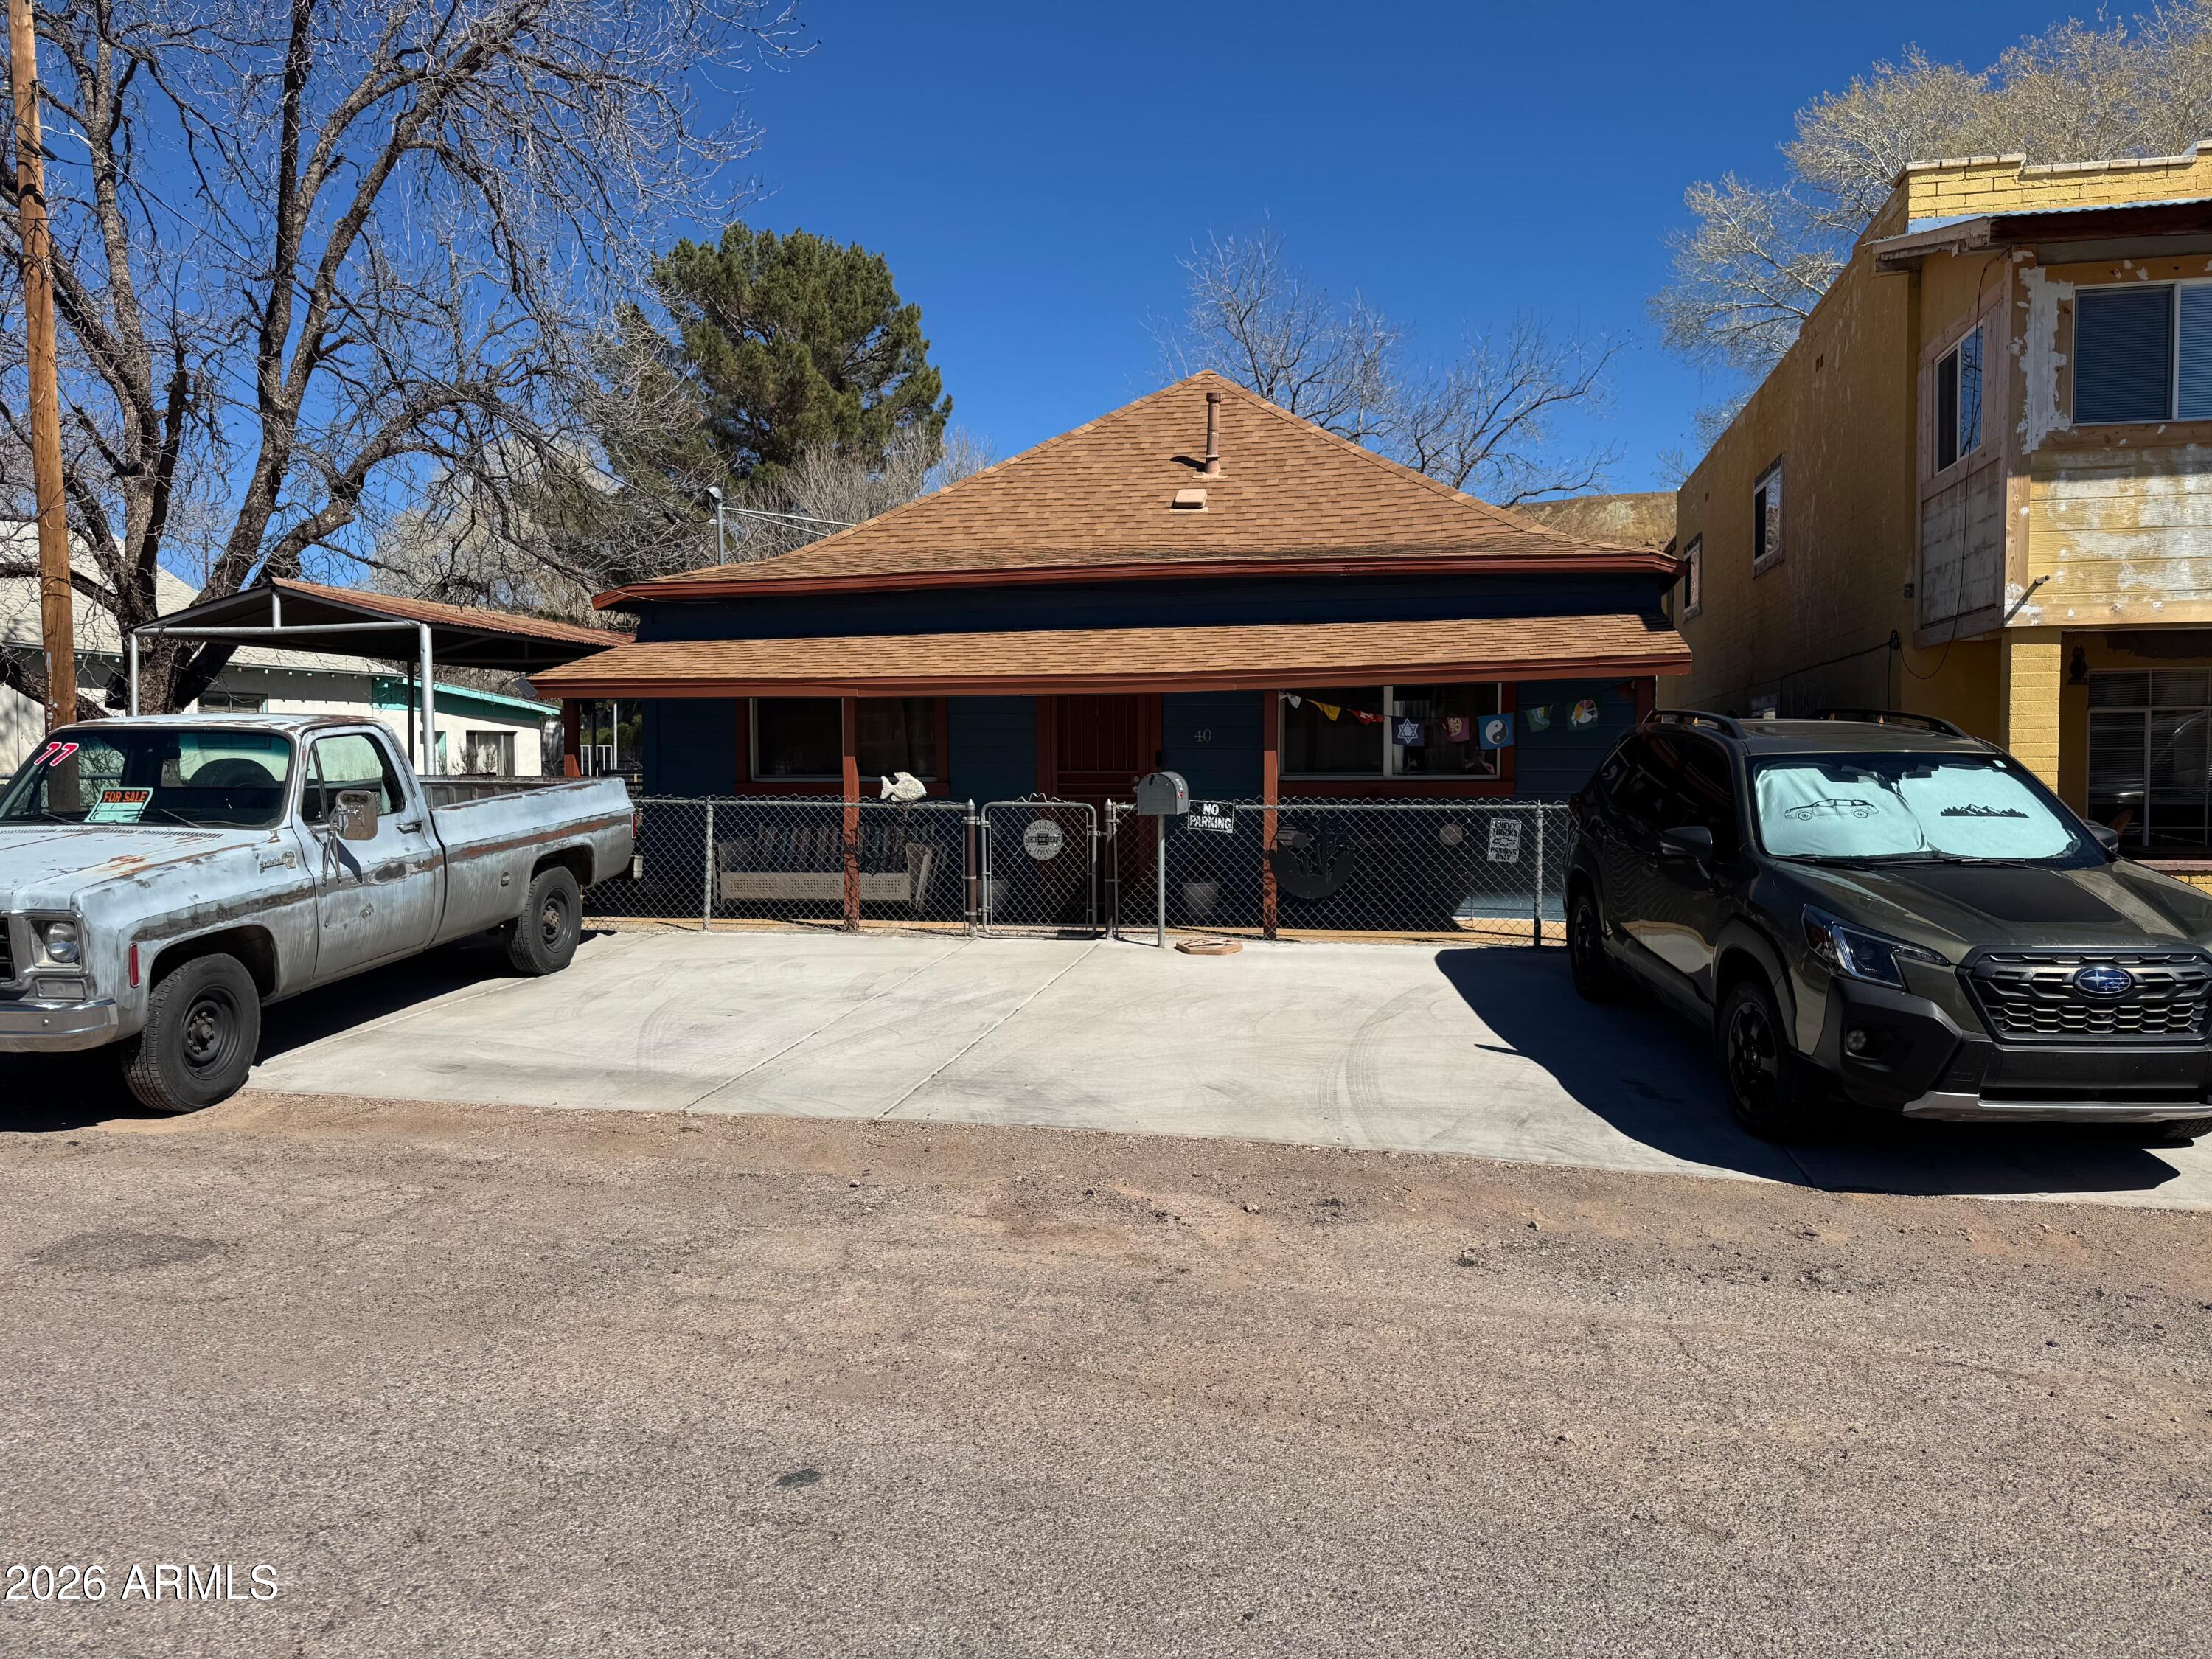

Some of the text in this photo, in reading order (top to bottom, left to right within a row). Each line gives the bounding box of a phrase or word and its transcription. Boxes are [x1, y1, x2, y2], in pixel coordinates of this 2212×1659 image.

[1194, 728, 1212, 742] 40
[34, 742, 79, 766] 77
[103, 791, 147, 803] FOR SALE
[1203, 803, 1220, 815] NO
[1189, 815, 1231, 830] PARKING
[1492, 828, 1518, 836] TRUCKS
